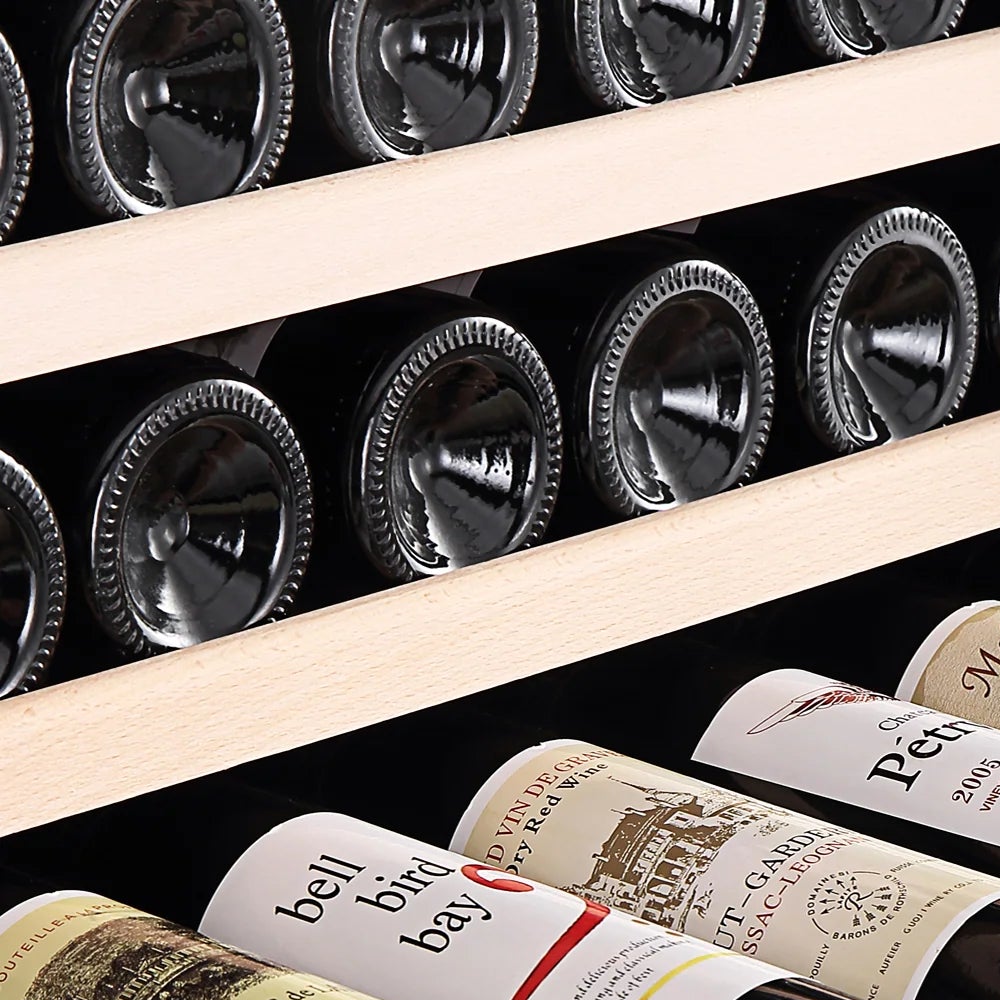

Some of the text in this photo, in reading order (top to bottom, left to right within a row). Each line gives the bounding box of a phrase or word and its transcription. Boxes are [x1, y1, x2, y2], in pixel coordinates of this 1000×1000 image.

[496, 800, 531, 837] VIN
[523, 772, 559, 798] DE
[524, 794, 562, 835] Red
[555, 763, 609, 790] Wine
[952, 757, 1000, 804] 2005
[274, 854, 367, 924] bell
[354, 857, 456, 913] bird
[399, 893, 492, 954] bay
[832, 925, 877, 940] BARONS
[879, 914, 896, 927] DE
[286, 990, 315, 1000] de
